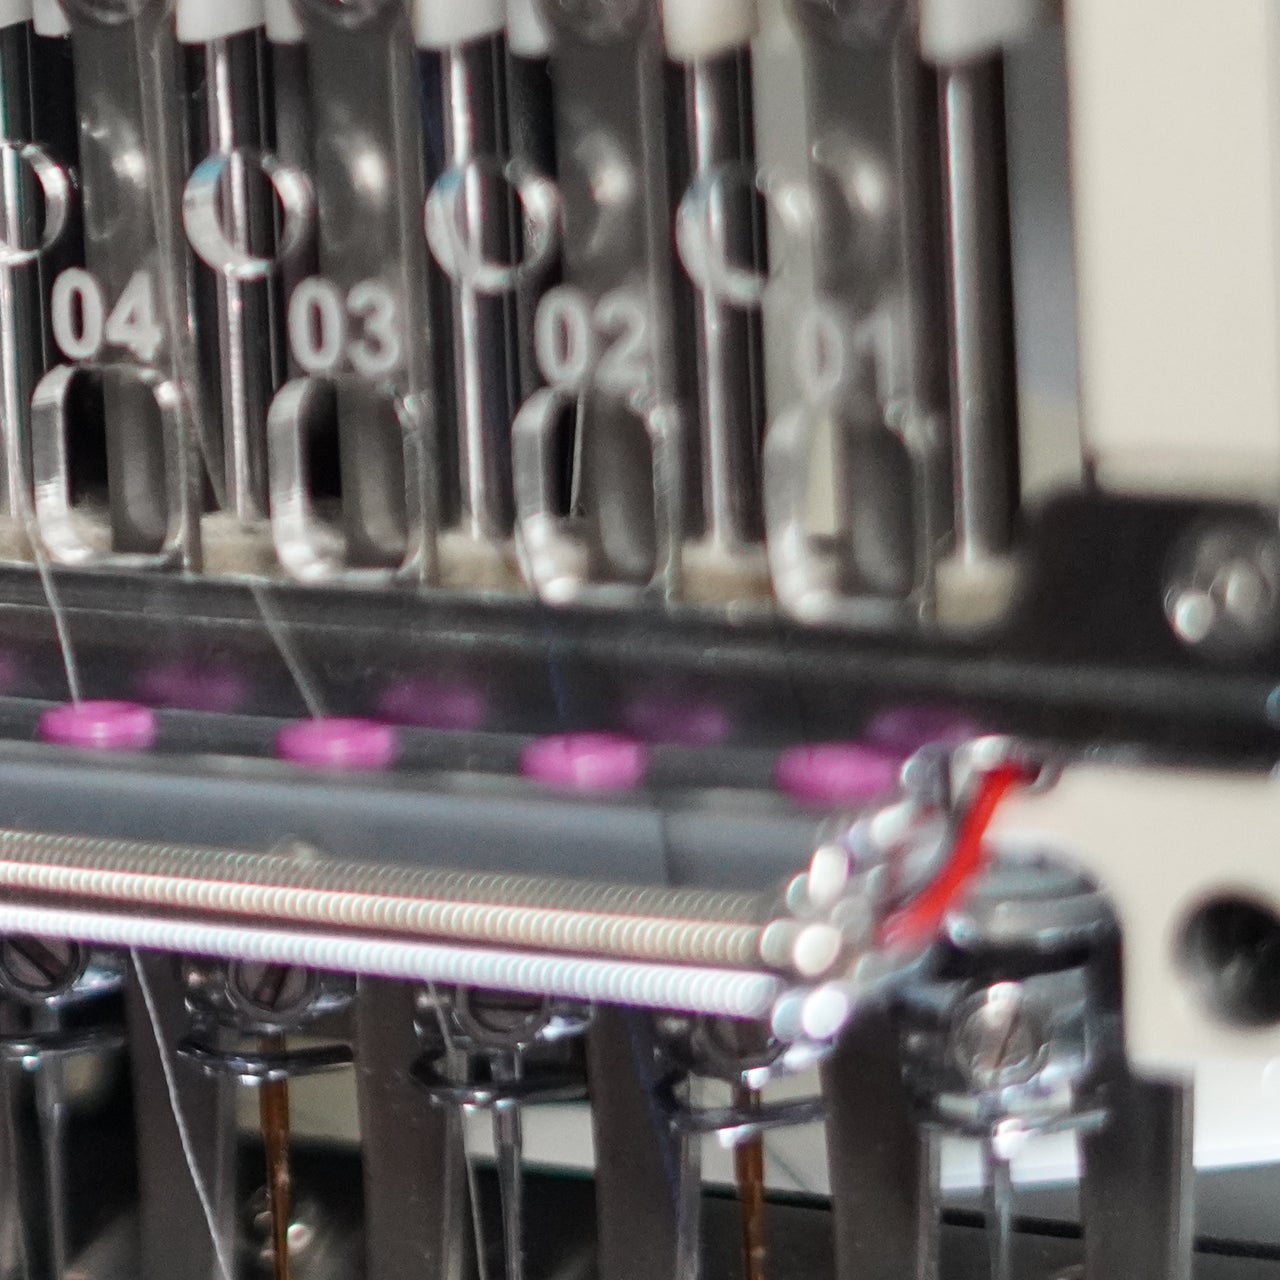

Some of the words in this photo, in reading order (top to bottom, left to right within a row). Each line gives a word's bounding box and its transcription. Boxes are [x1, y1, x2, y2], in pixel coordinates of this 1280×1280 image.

[51, 266, 163, 362] 04
[288, 274, 402, 377] 03
[535, 284, 648, 391] 02
[793, 297, 902, 406] 01
